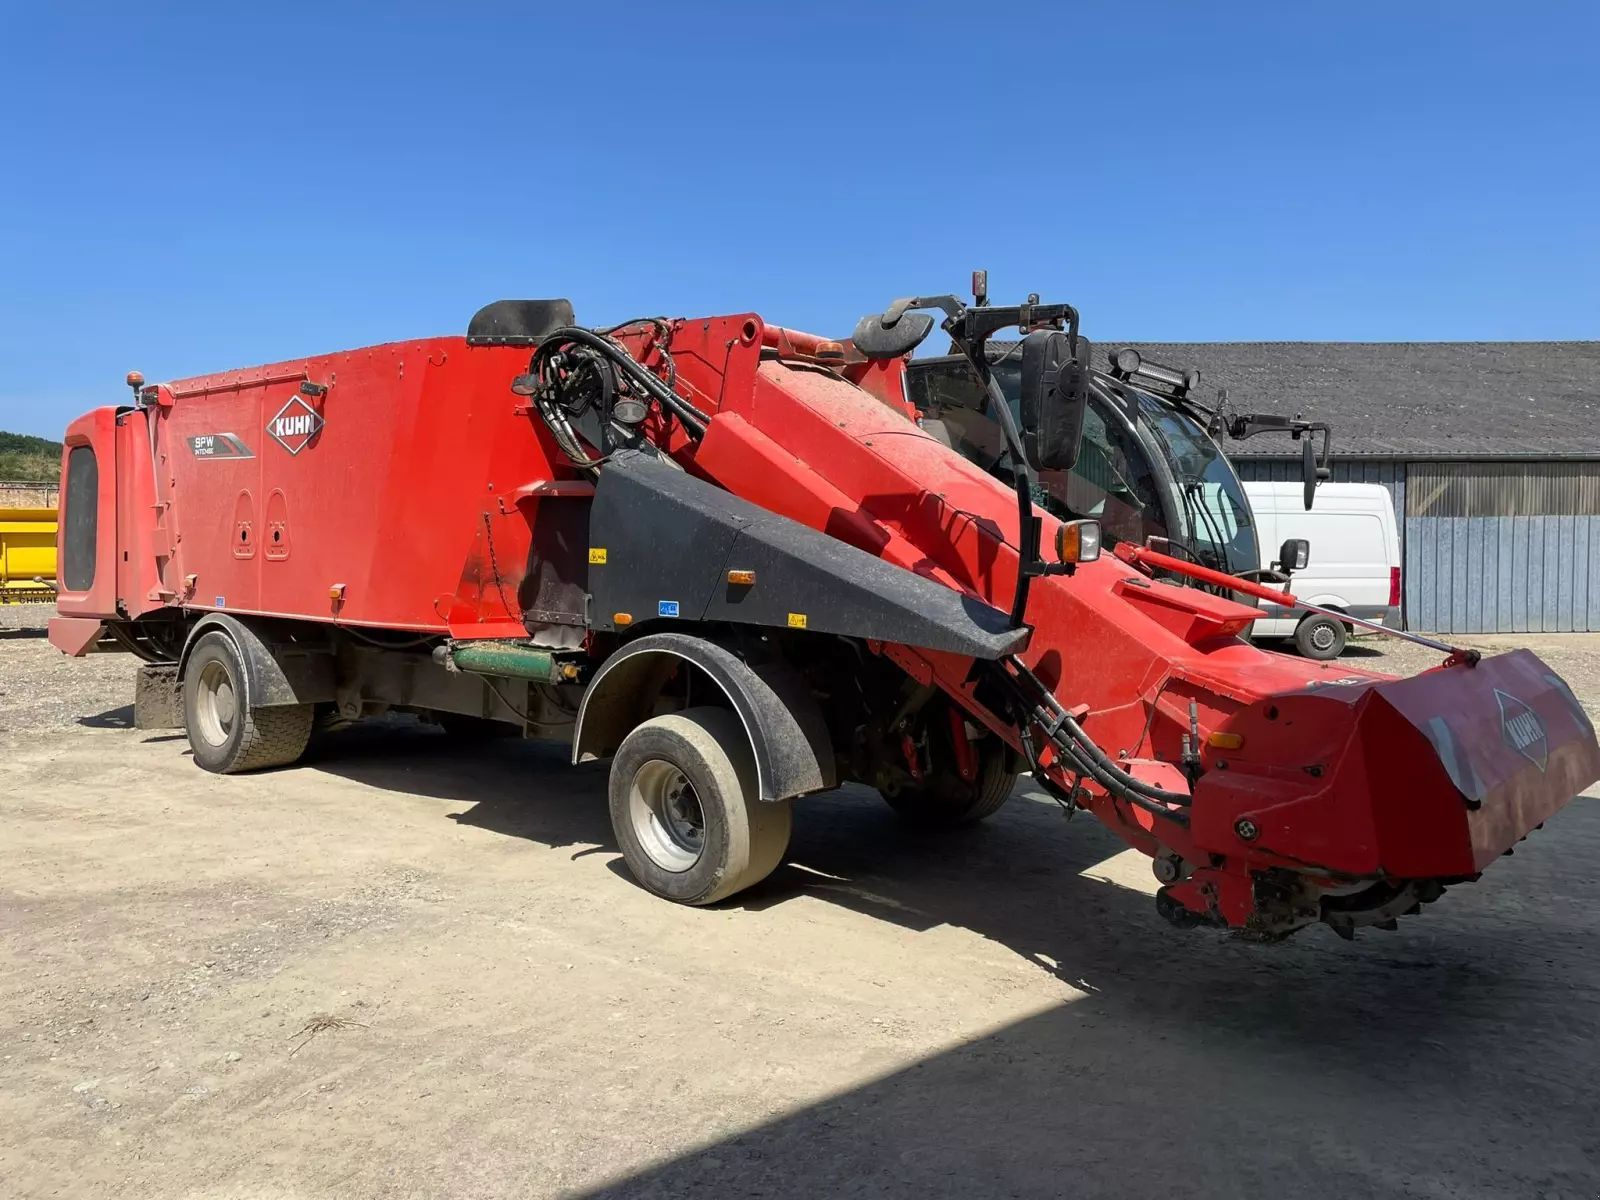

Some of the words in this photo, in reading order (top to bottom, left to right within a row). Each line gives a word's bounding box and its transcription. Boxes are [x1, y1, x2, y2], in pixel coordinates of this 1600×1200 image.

[275, 414, 315, 437] KUHN
[195, 436, 214, 448] SPW
[1505, 711, 1545, 750] KUHN
